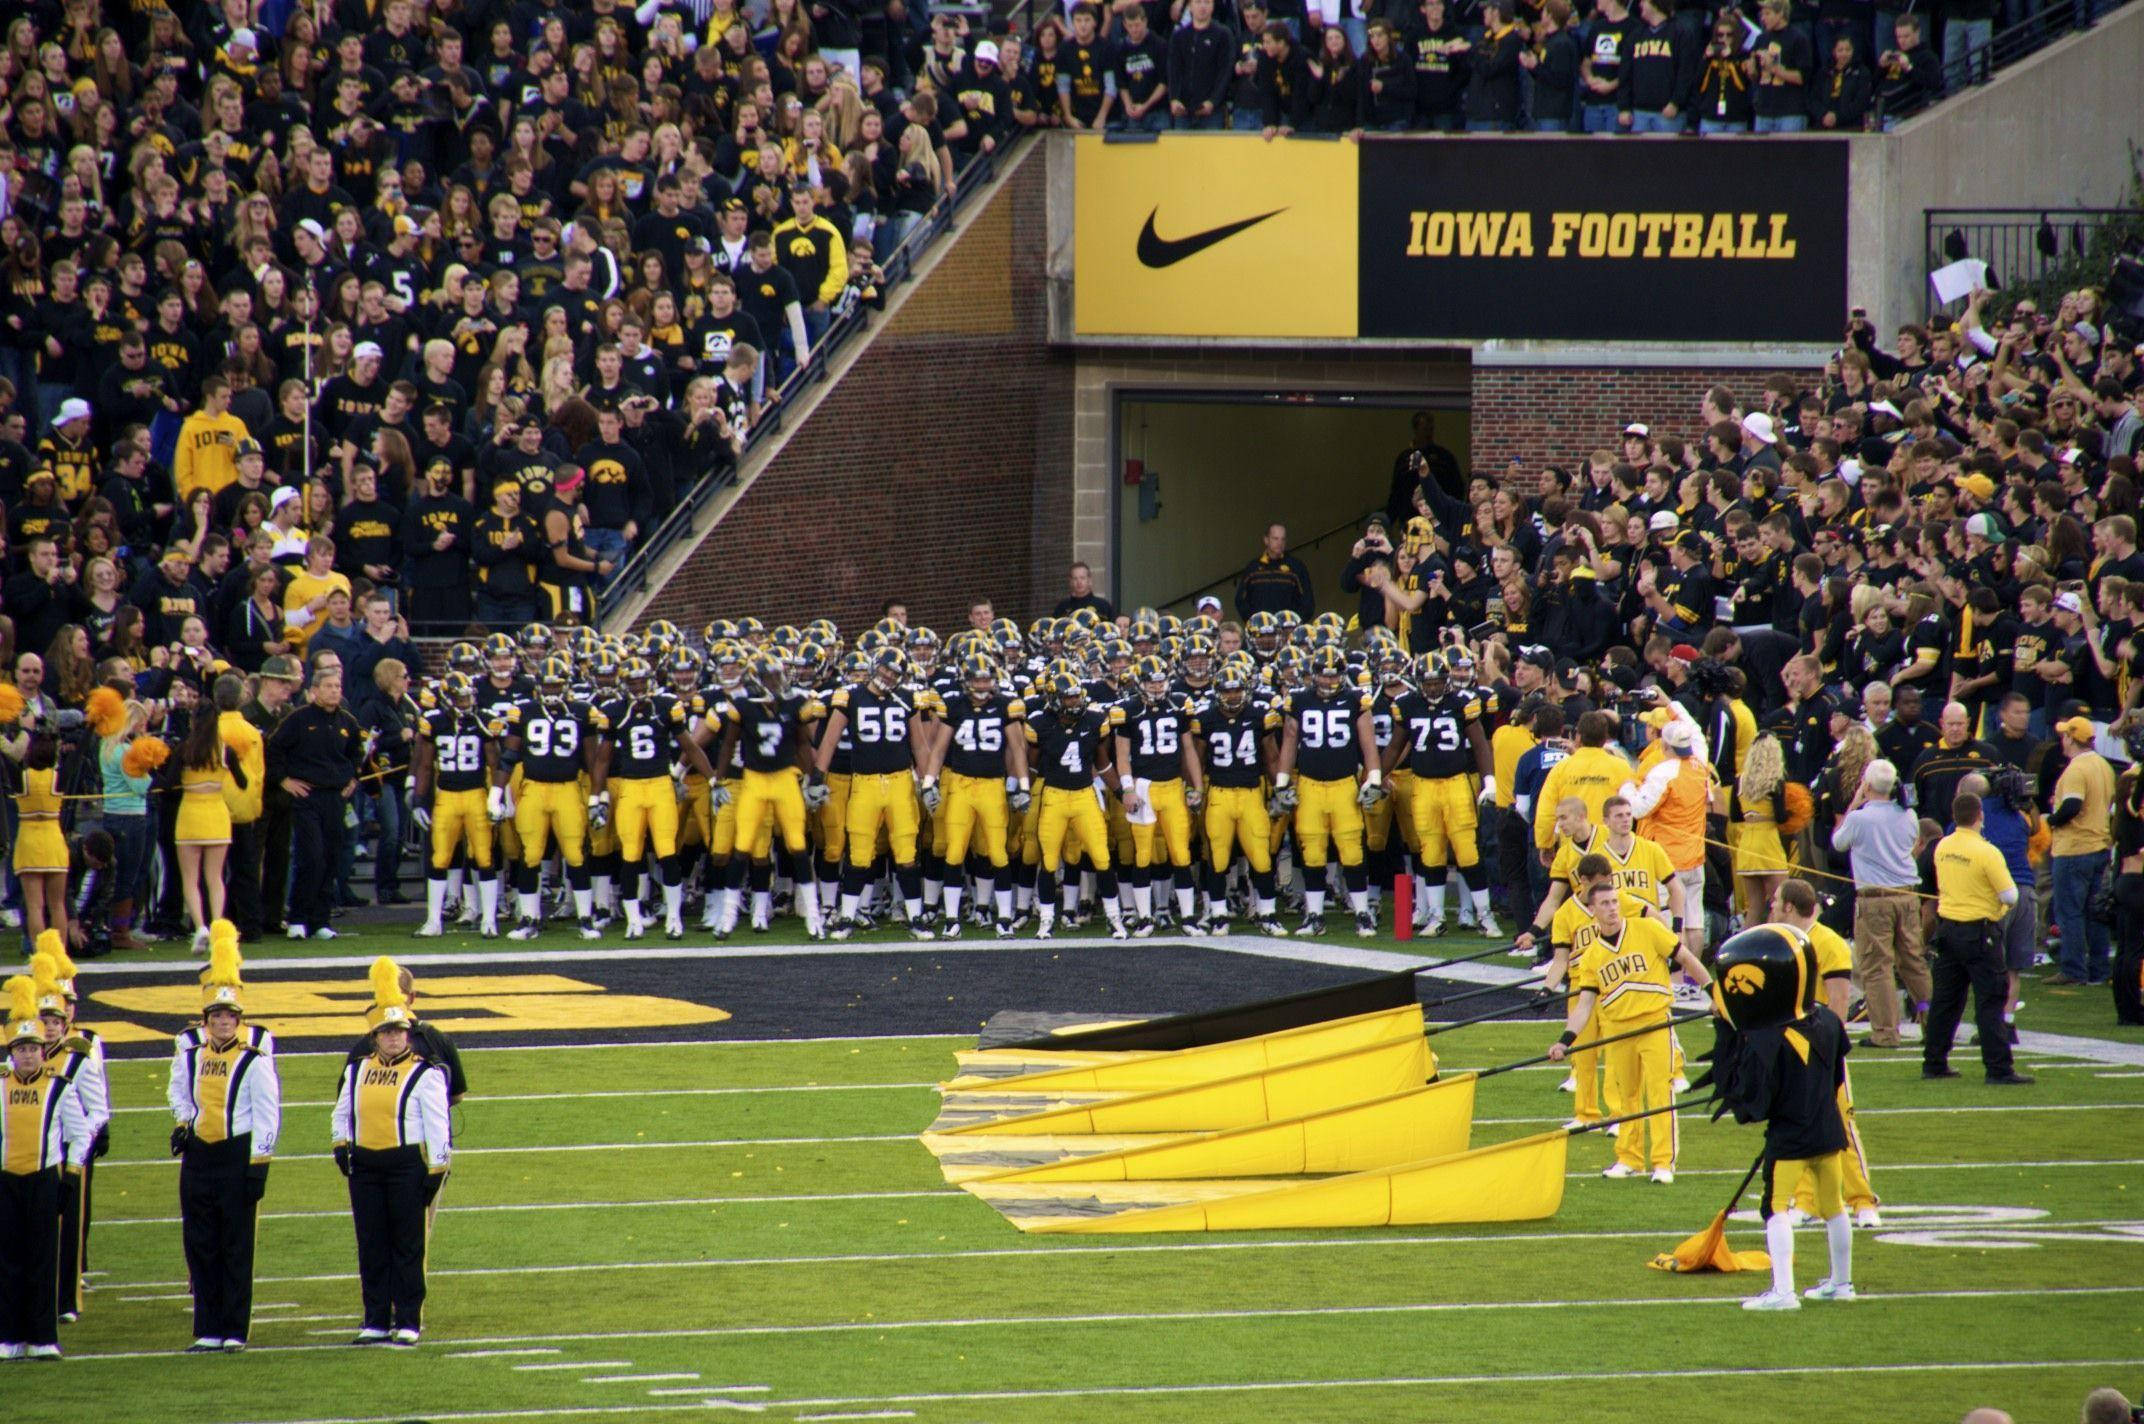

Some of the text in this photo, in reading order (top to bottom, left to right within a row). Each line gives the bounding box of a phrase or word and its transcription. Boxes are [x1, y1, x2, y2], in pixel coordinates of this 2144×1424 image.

[1633, 39, 1672, 58] IOWA
[1406, 211, 1796, 259] IOWA FOOTBALL
[393, 271, 414, 307] 5
[150, 343, 189, 363] IOWA
[515, 465, 556, 486] IOWA
[420, 511, 459, 527] IOWA
[526, 718, 579, 758] 93
[857, 707, 907, 742] 56
[954, 717, 1002, 751] 45
[1137, 716, 1178, 755] 16
[1302, 709, 1350, 748] 95
[1410, 716, 1460, 752] 73
[435, 734, 481, 772] 28
[630, 725, 656, 760] 6
[1060, 741, 1083, 774] 4
[1209, 730, 1257, 767] 34
[1610, 869, 1649, 890] OWA
[1575, 923, 1602, 950] IOW
[1599, 953, 1649, 988] IOWA
[202, 1060, 228, 1078] IOWA
[364, 1068, 399, 1087] IOWA
[9, 1089, 39, 1106] IOWA
